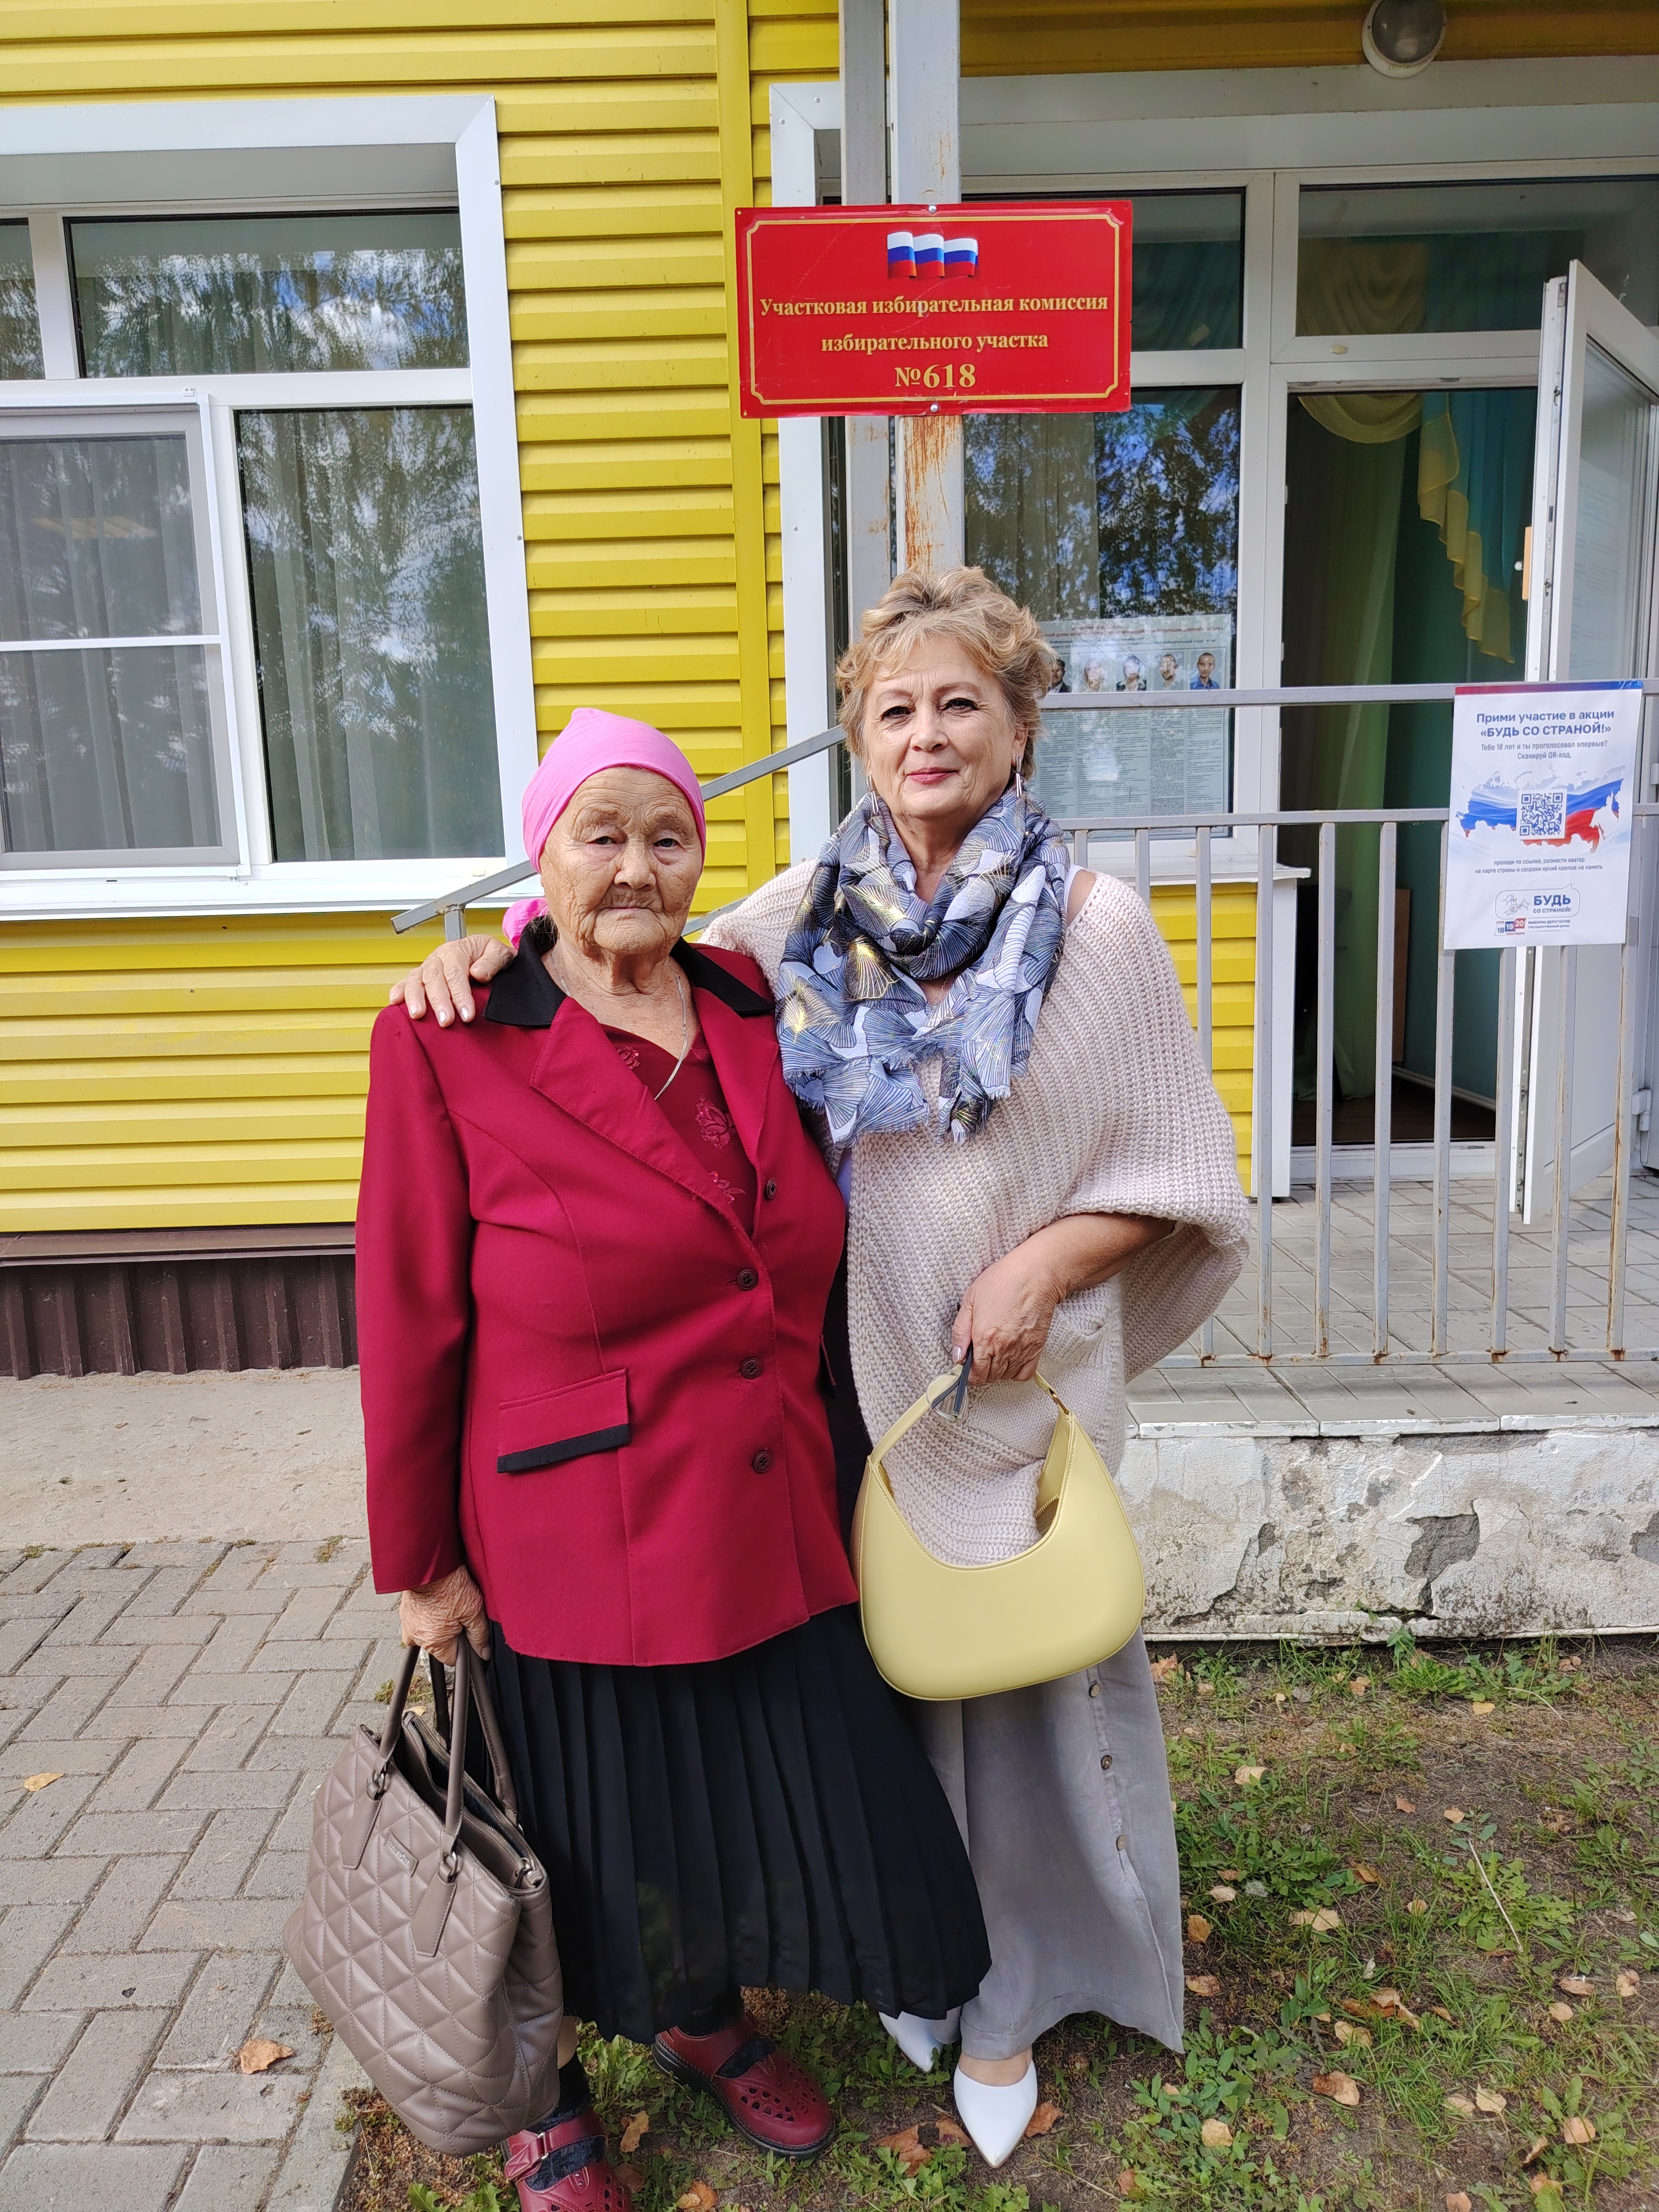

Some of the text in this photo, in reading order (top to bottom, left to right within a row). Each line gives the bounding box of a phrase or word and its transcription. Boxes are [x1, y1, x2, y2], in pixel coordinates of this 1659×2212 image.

[759, 295, 1108, 317] Участковая избирательная комиссия
[821, 333, 1048, 356] избирательного участка
[894, 363, 976, 389] №618
[1477, 713, 1516, 725] Прими
[1519, 713, 1566, 724] участие
[1579, 711, 1614, 720] акции
[1480, 721, 1611, 738] «БУДЬ СО СТРАНОЙ!»
[1532, 742, 1575, 750] проголосовал
[1577, 740, 1608, 749] впервые?
[1517, 752, 1547, 760] Сканируй
[1533, 895, 1571, 907] БУДЬ
